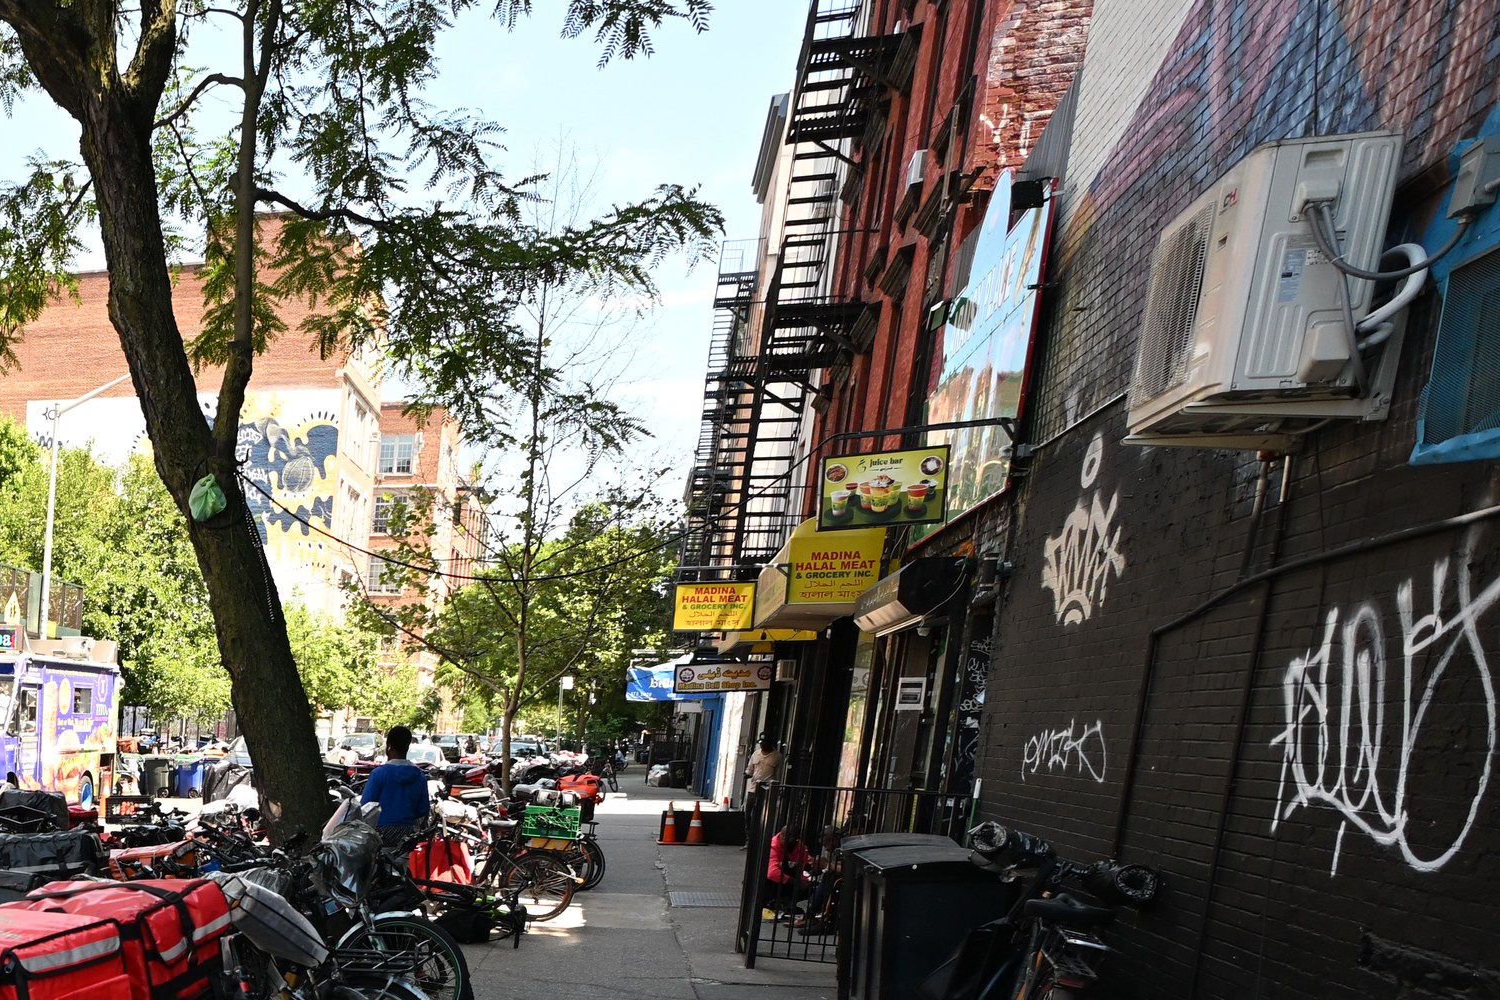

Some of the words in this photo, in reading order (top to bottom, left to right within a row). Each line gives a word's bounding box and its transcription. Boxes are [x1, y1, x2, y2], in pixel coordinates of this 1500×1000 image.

[811, 551, 861, 560] MADINA
[795, 562, 836, 571] HALAL
[840, 560, 875, 569] MEAT
[805, 571, 851, 579] GROCERY
[681, 595, 715, 603] HALAL
[719, 595, 748, 603] MEAT
[678, 682, 704, 690] Madina
[722, 682, 741, 690] Shop
